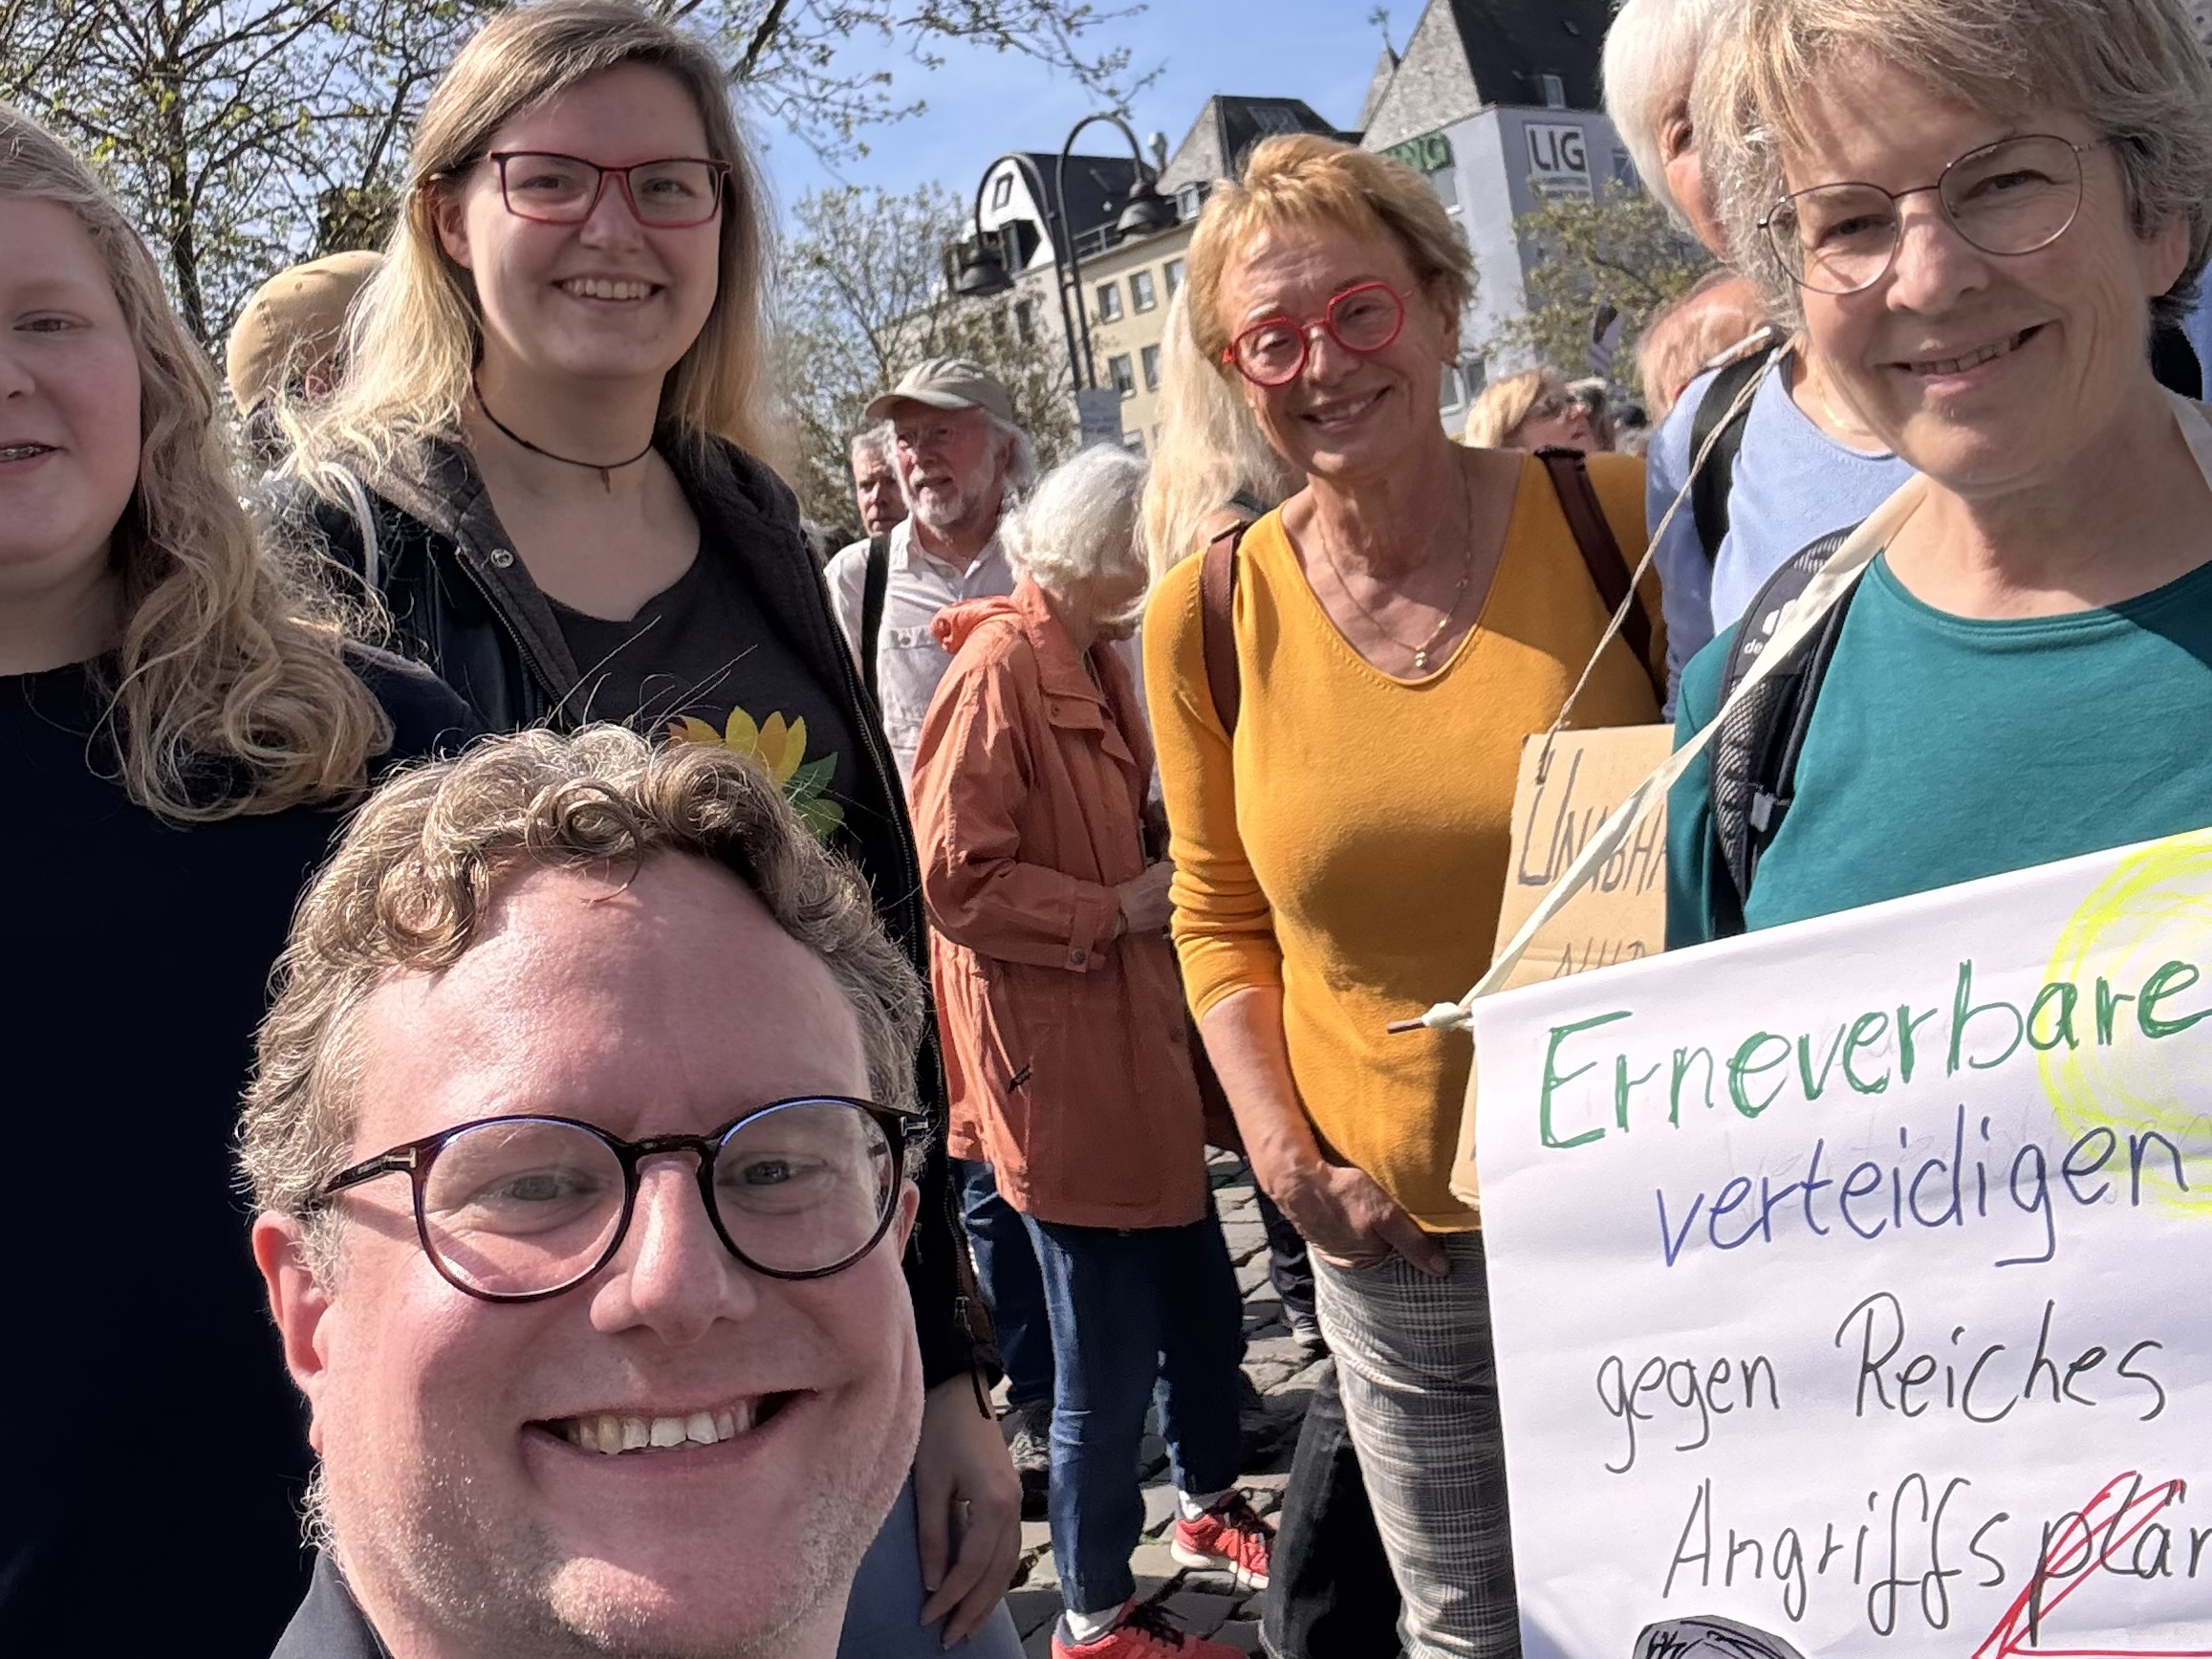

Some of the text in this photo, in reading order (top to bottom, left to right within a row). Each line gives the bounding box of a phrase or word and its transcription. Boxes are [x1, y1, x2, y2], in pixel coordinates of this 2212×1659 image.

[1529, 128, 1586, 172] LIG
[1656, 1102, 2190, 1268] verteidigen
[1596, 1291, 2165, 1473] gegen Reiches
